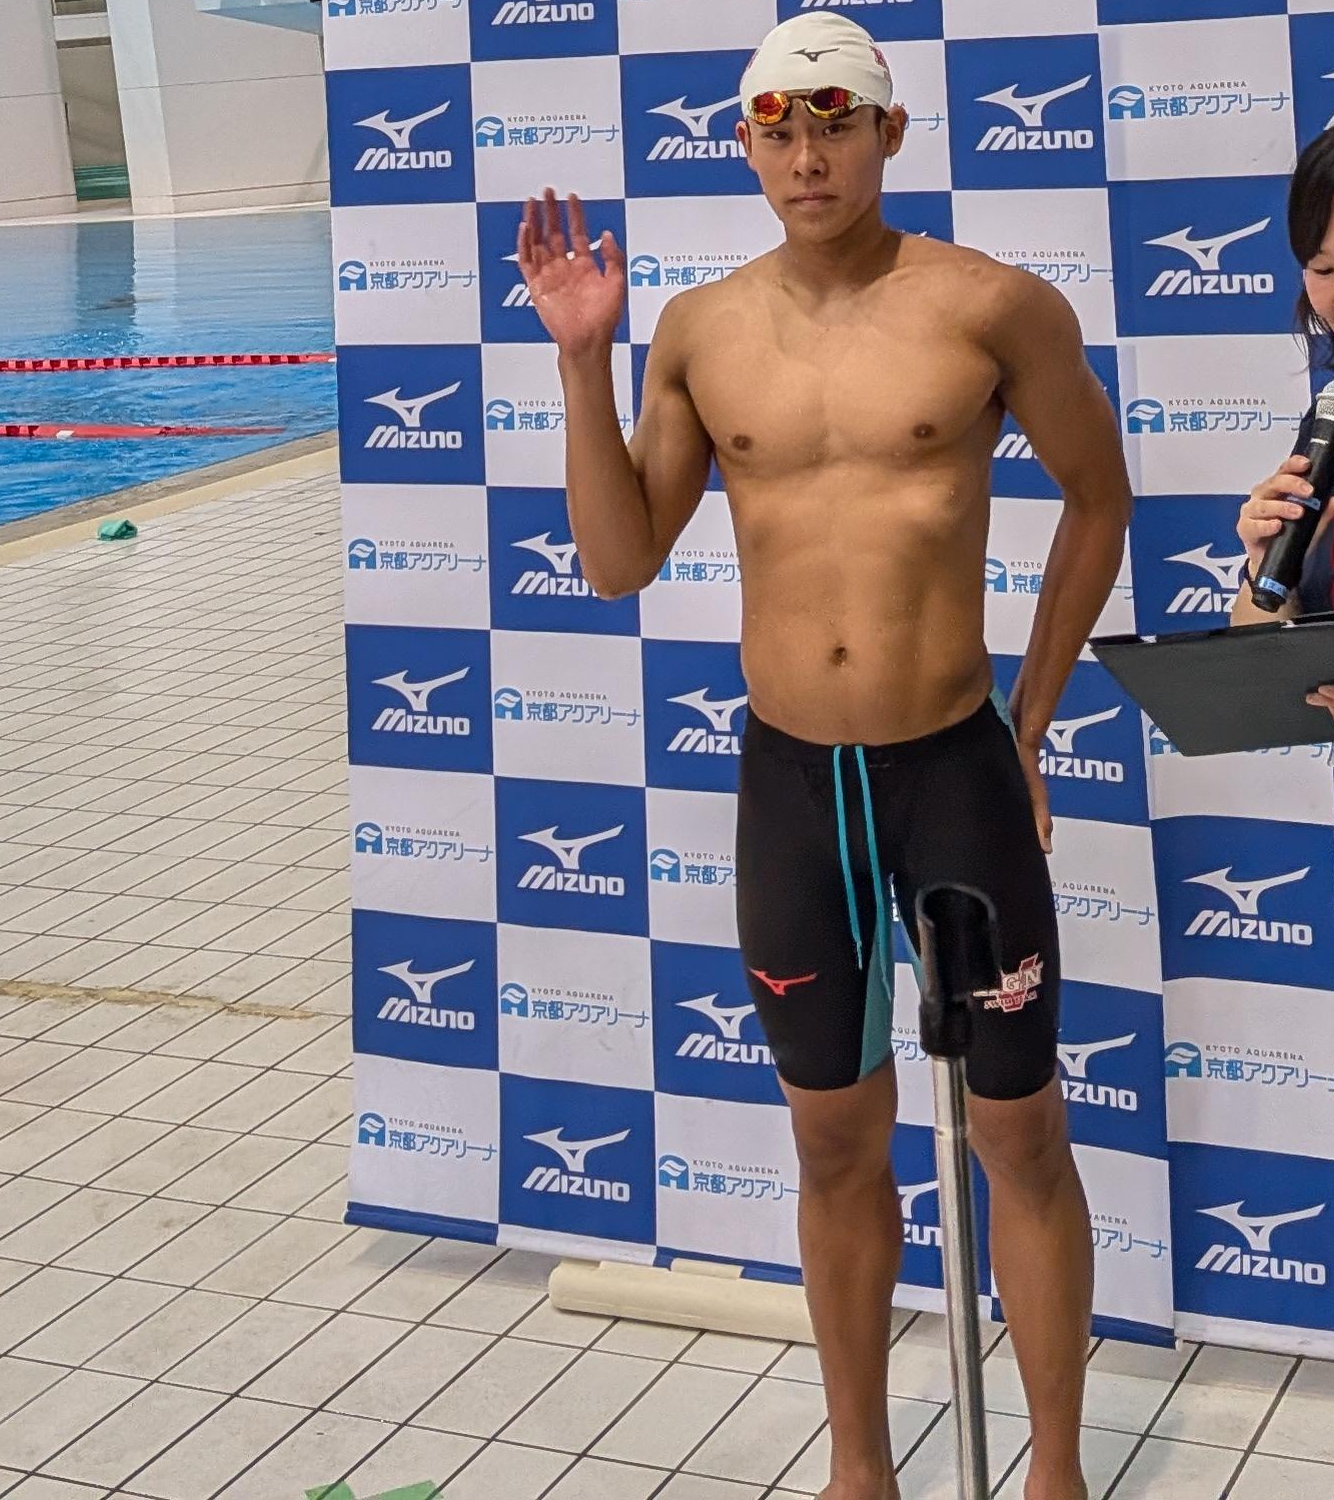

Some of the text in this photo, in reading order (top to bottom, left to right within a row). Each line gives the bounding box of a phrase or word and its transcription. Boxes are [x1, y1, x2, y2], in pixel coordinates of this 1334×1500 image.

[492, 1, 594, 25] MIZUNO
[1148, 80, 1247, 92] KYOTO AQUARENA
[1149, 93, 1289, 117] 京都アクアリーナ
[508, 125, 618, 145] 京都アクアリーナ
[976, 126, 1093, 150] MIZUNO
[355, 148, 451, 170] MIZUNO
[370, 271, 476, 290] 京都アクアリーナ
[1146, 270, 1273, 295] MIZUNO
[1168, 398, 1267, 407] KYOTO AQUARENA
[364, 426, 462, 448] MIZUNO
[380, 551, 486, 571] 京都アクアリーナ
[512, 571, 597, 597] MIZU
[372, 708, 469, 735] MIZUNO
[526, 702, 640, 725] 京都アクアリーナ
[386, 837, 493, 862] 京都アクアリーナ
[518, 865, 624, 895] MIZUNO
[1185, 910, 1312, 945] MIZUNO
[377, 997, 474, 1029] MIZUNO
[532, 1000, 649, 1027] 京都アクアリーナ
[676, 1033, 777, 1065] MIZUN
[1205, 1044, 1305, 1062] KYOTO AQUARENA
[389, 1131, 496, 1161] 京都アクアリーナ
[523, 1167, 629, 1201] MIZUNO
[693, 1172, 799, 1200] 京都アクアリー
[1195, 1245, 1325, 1284] MIZUNO
